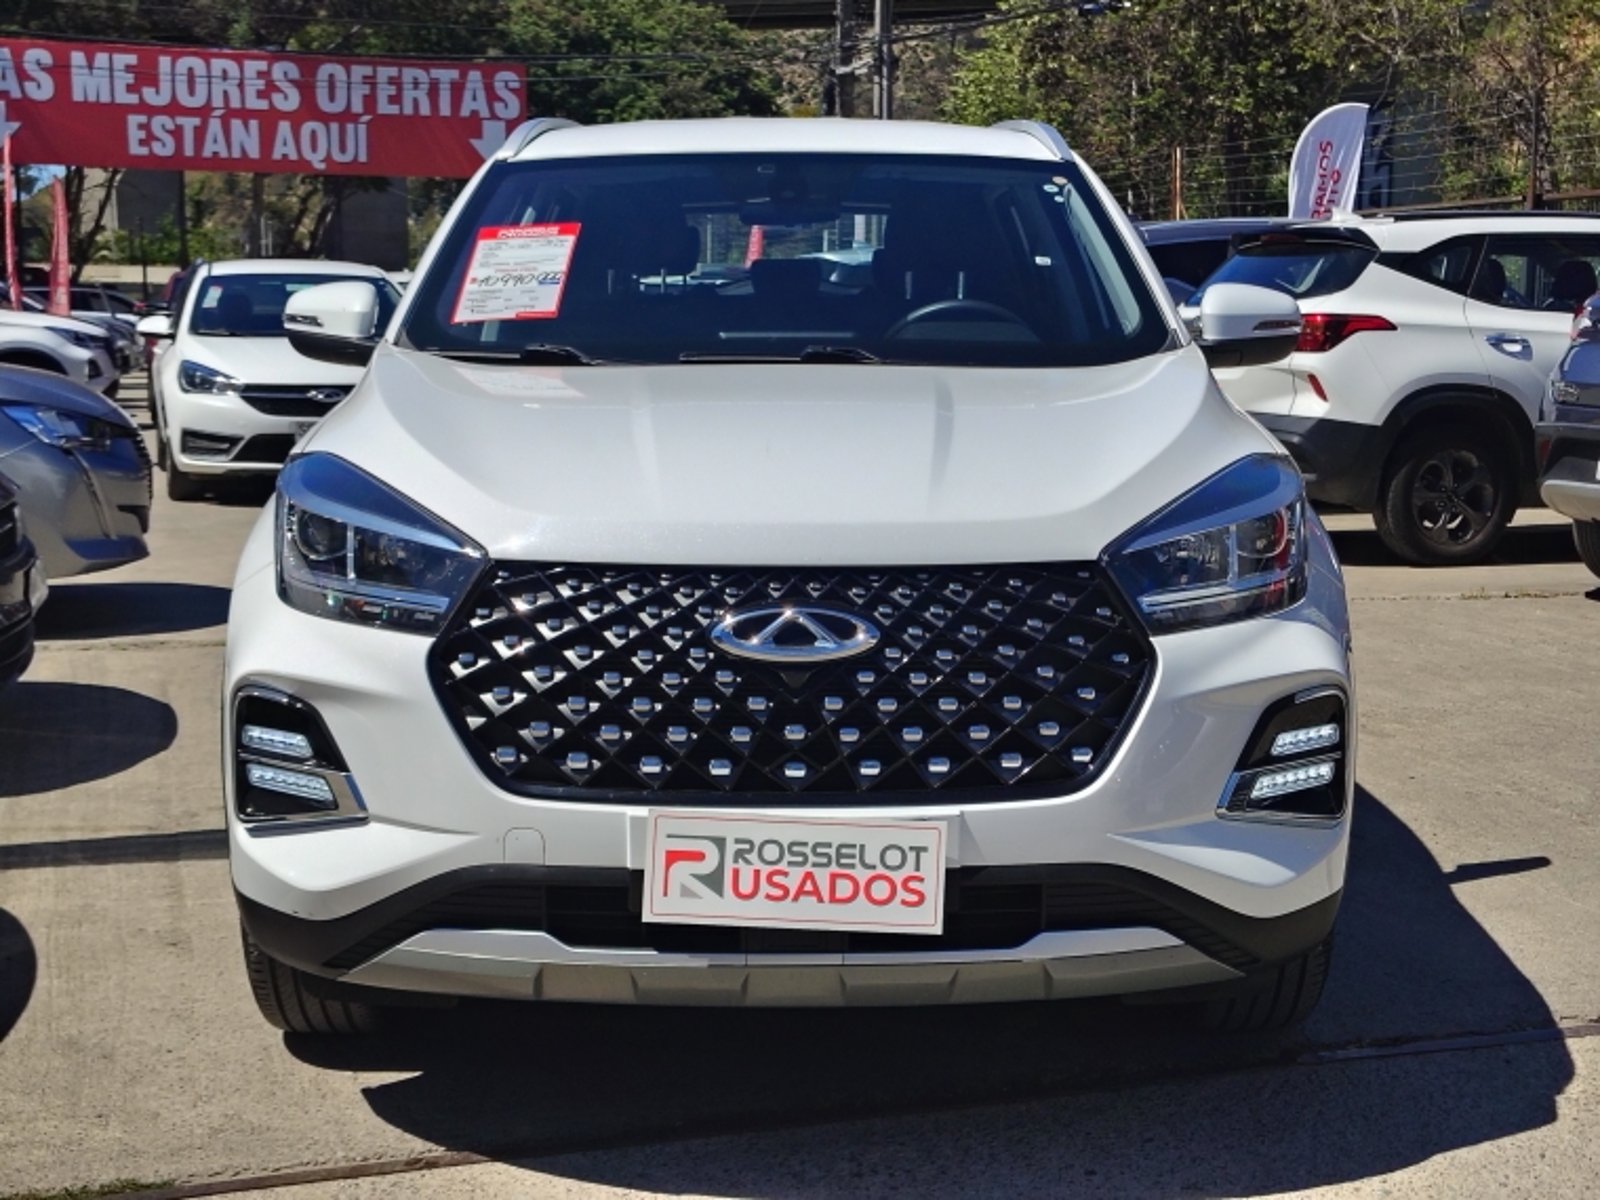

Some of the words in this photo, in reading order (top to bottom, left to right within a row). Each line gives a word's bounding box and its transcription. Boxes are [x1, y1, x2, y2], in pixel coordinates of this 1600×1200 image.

[70, 51, 300, 111] MEJORES
[315, 62, 522, 120] OFERTAS
[127, 109, 260, 159] ESTÁN
[272, 115, 373, 170] AQUÍ
[732, 837, 929, 872] ROSSELOT
[731, 867, 926, 908] USADOS
